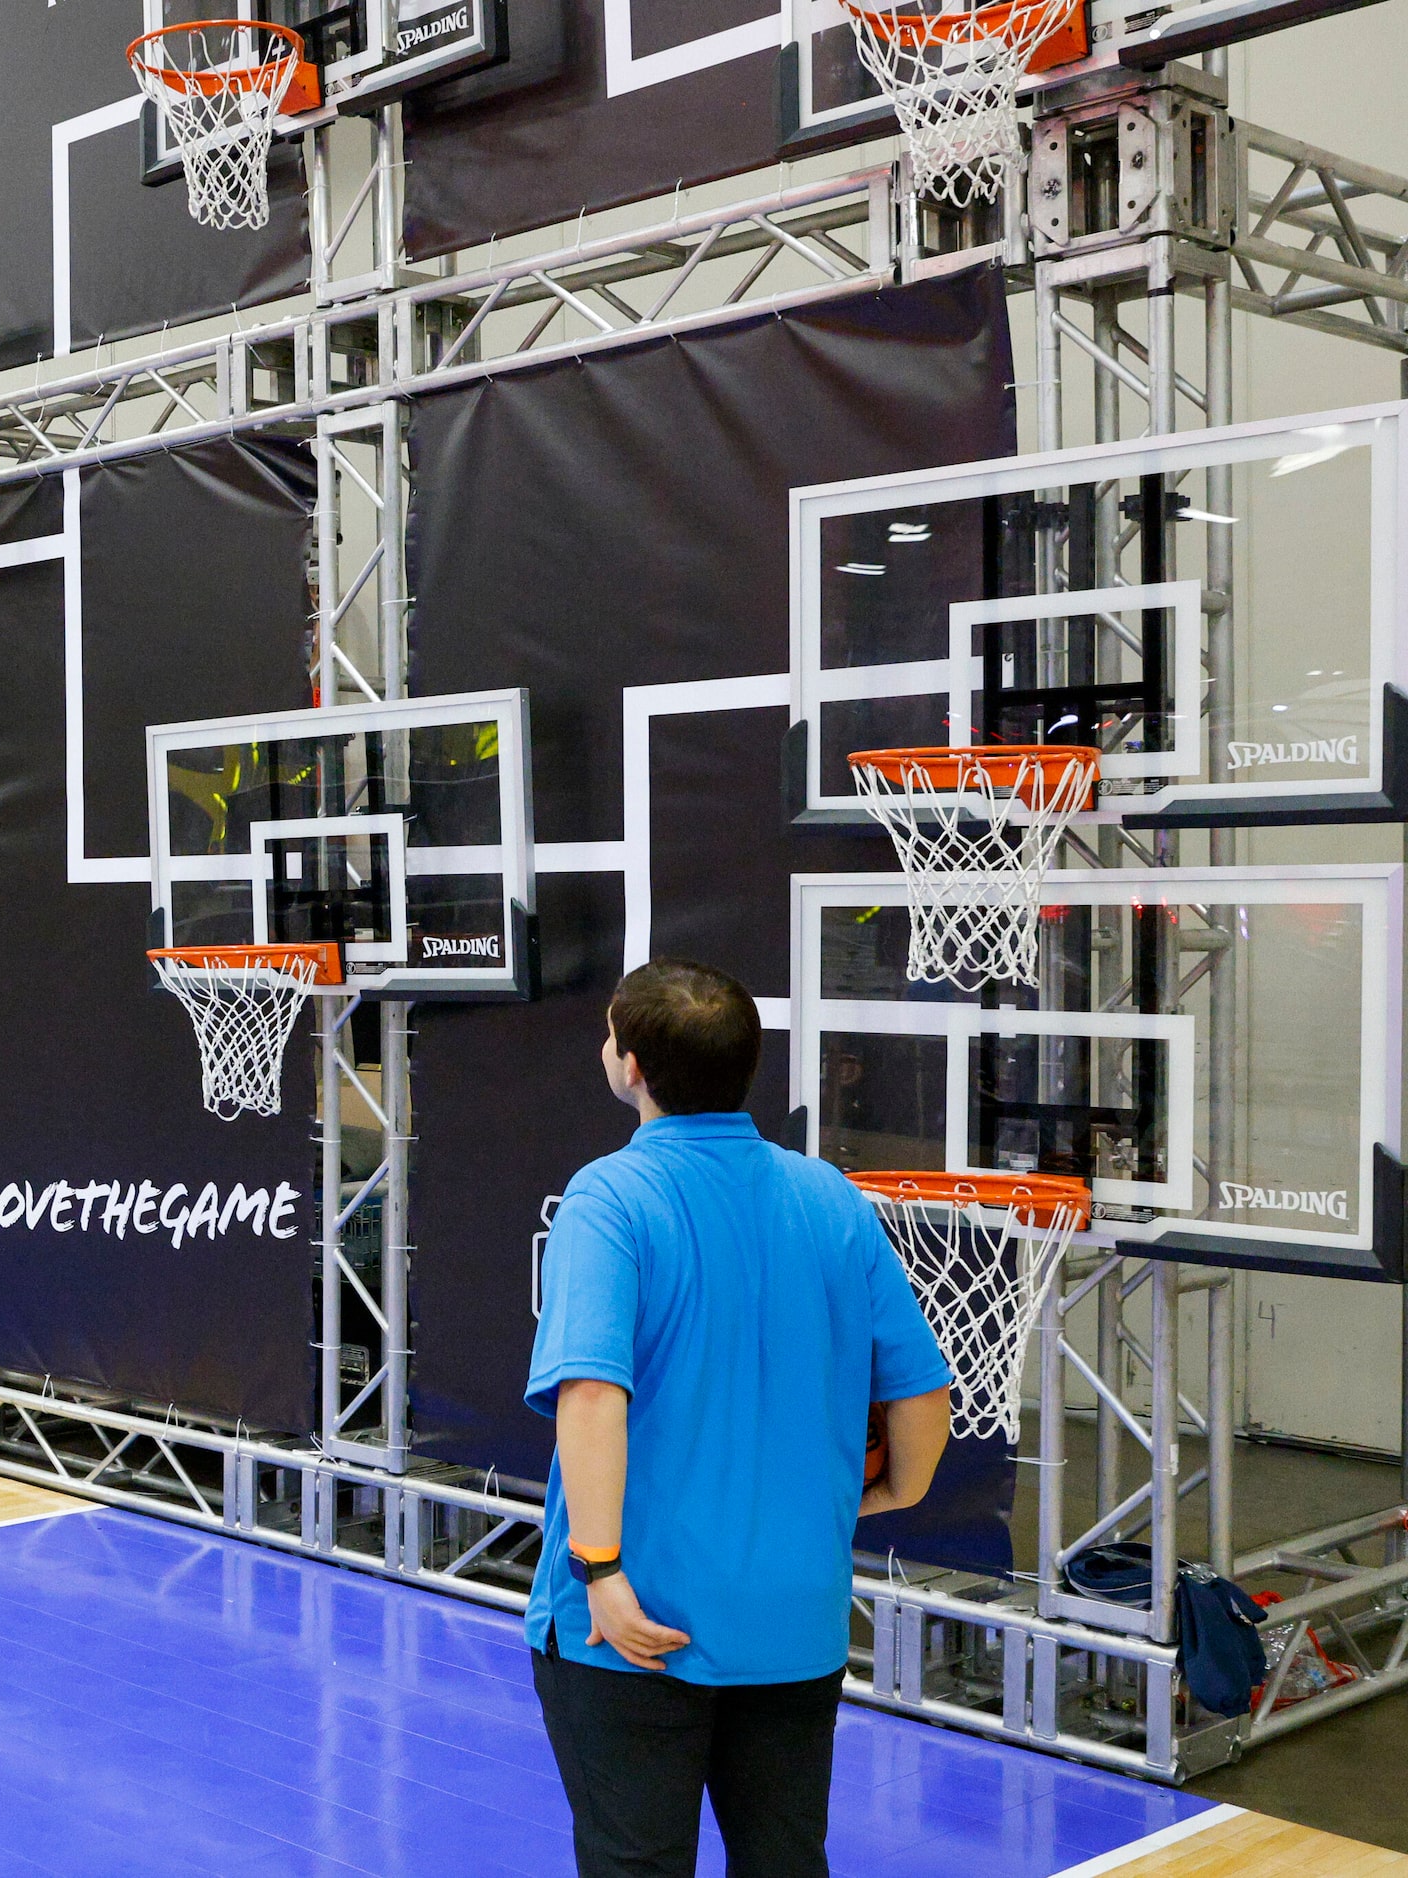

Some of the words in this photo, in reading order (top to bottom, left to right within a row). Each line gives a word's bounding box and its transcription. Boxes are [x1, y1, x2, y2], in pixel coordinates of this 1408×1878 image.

[396, 5, 469, 54] SPALDING
[1227, 735, 1360, 770] SPALDING
[422, 934, 501, 959] SPALDING
[1219, 1181, 1350, 1221] SPALDING
